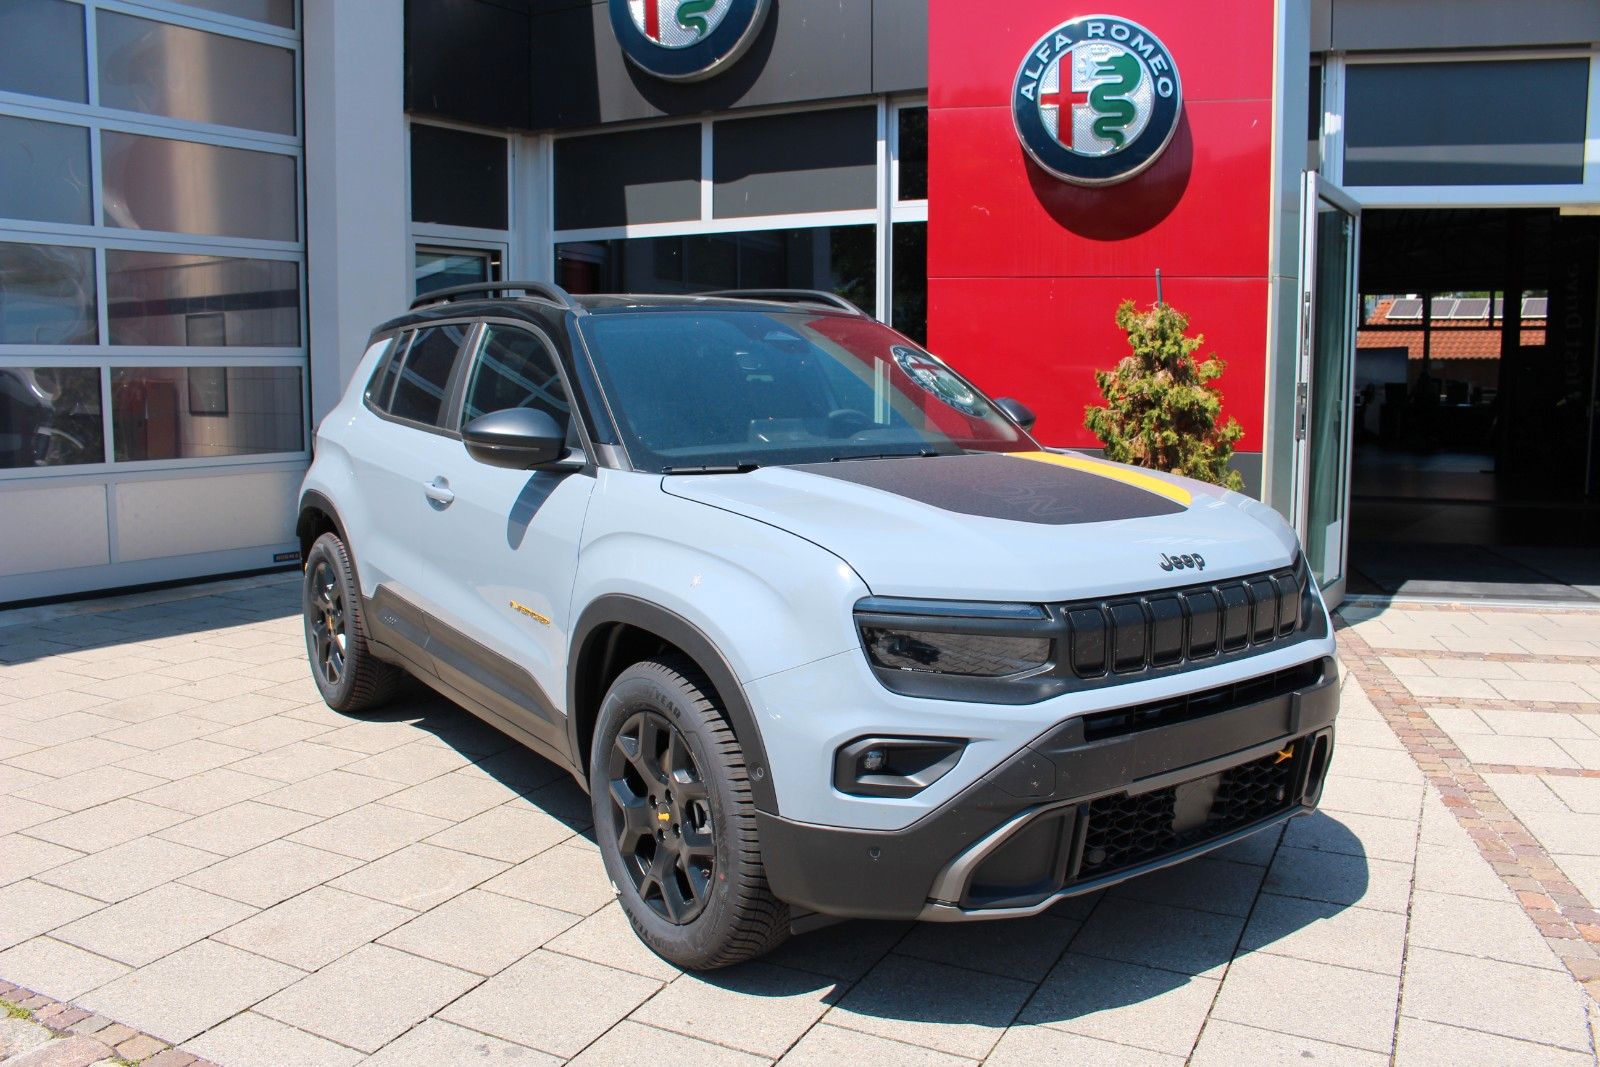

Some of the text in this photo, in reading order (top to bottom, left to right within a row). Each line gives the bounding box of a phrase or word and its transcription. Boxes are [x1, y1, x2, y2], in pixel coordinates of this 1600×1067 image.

[1020, 21, 1174, 101] ALFA ROMEO
[1159, 553, 1205, 571] Jeep
